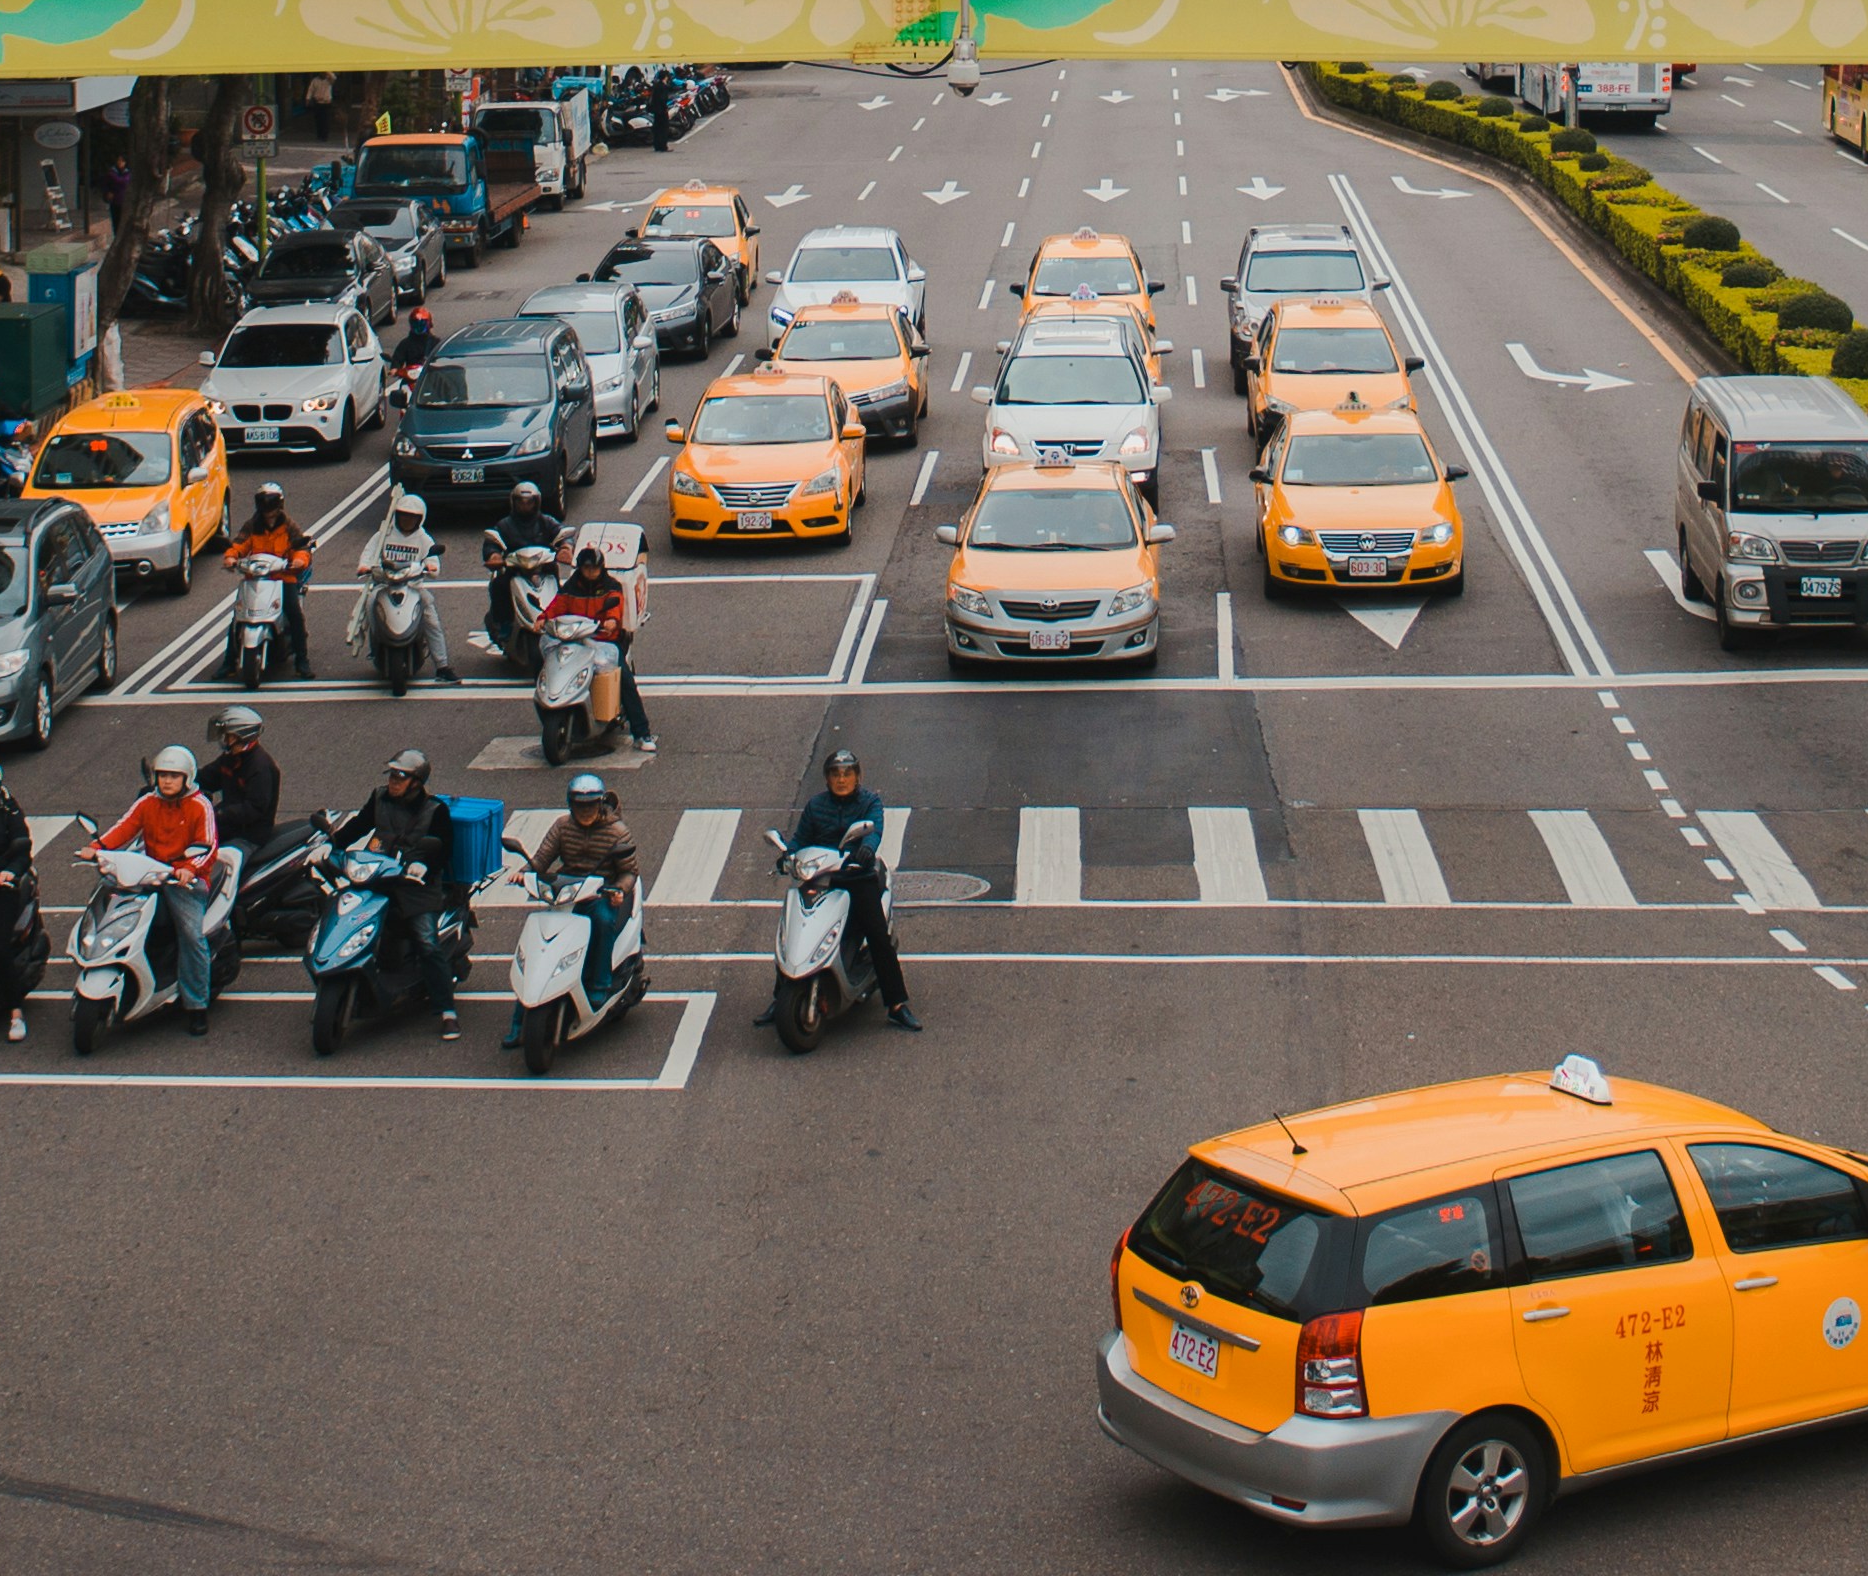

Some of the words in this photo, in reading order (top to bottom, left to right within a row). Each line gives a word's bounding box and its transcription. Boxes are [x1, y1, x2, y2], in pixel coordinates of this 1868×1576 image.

[1351, 561, 1385, 573] 603-3C
[1032, 634, 1068, 647] 068-E2
[1184, 1178, 1281, 1244] 472-E2
[1615, 1304, 1686, 1340] 472-E2
[1171, 1329, 1216, 1372] 472-E2
[1641, 1339, 1664, 1414] 林清涼
